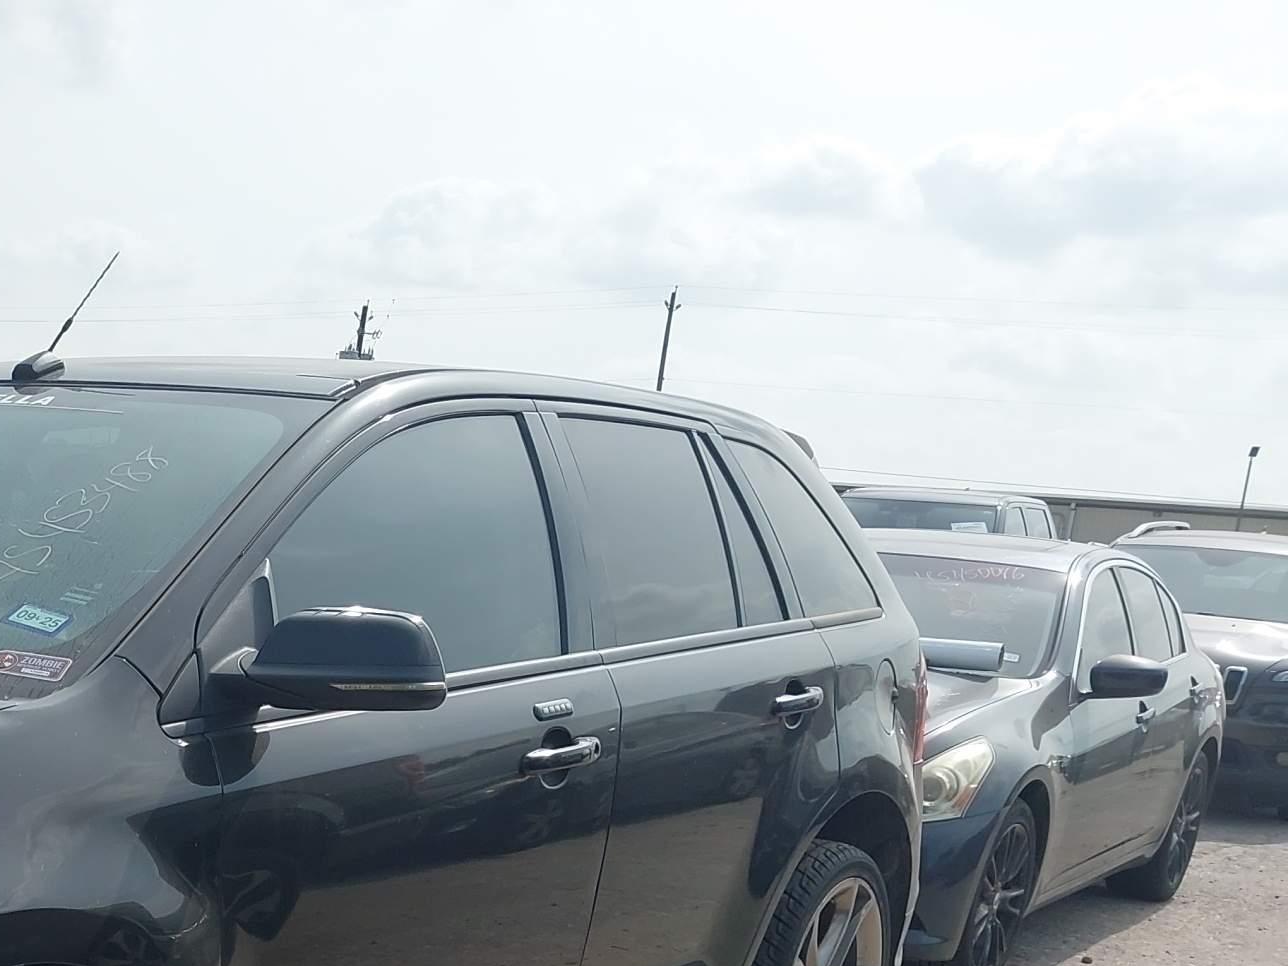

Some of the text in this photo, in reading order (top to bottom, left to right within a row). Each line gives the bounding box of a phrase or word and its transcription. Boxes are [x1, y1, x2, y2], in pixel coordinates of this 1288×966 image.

[16, 610, 62, 627] 09 25
[20, 656, 65, 669] ZOMBIE
